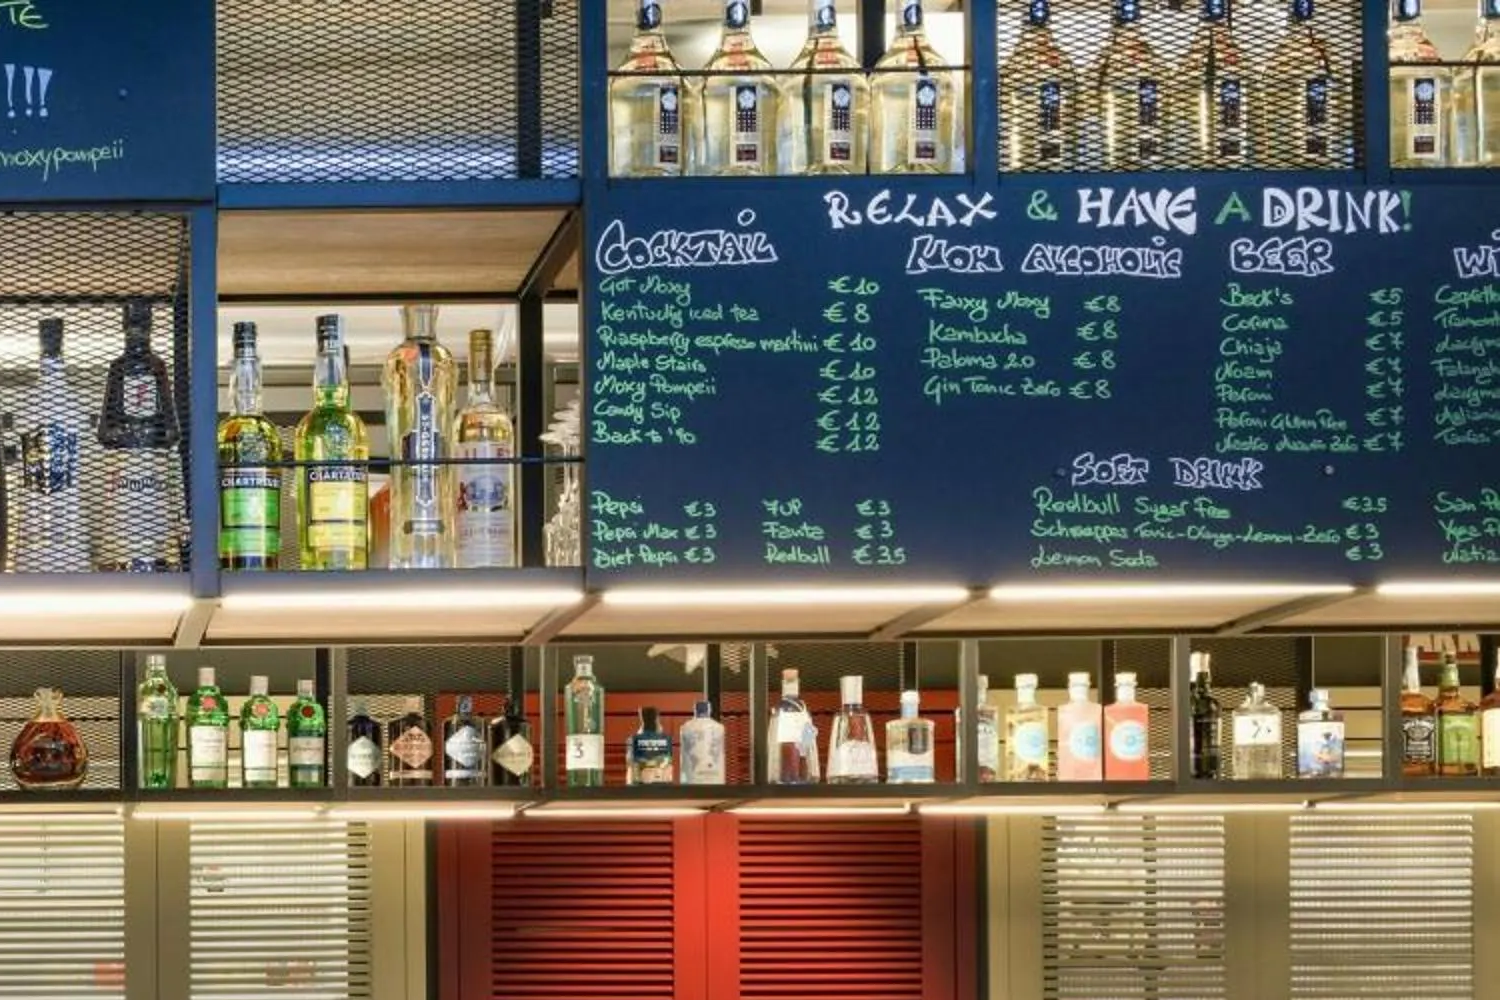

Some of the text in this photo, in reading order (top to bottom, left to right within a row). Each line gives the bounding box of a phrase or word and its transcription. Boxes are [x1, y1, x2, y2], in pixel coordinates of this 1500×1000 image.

[824, 188, 998, 229] RELAX
[1026, 189, 1059, 221] &
[1077, 187, 1197, 234] HAVE
[1215, 191, 1251, 225] A
[1230, 236, 1334, 277] BEER
[639, 274, 691, 306] Moxy
[1219, 282, 1295, 308] Beck's
[997, 291, 1051, 319] Moxy
[596, 350, 650, 376] Maple
[920, 347, 998, 370] Paloma
[593, 374, 646, 403] Moxy
[923, 375, 961, 406] Gin
[650, 401, 682, 424] Sip
[1071, 451, 1266, 490] SOFT DRINK
[592, 491, 645, 516] Pepsi
[642, 522, 678, 540] Max
[762, 521, 825, 541] Fanta
[1030, 546, 1102, 568] Lemon
